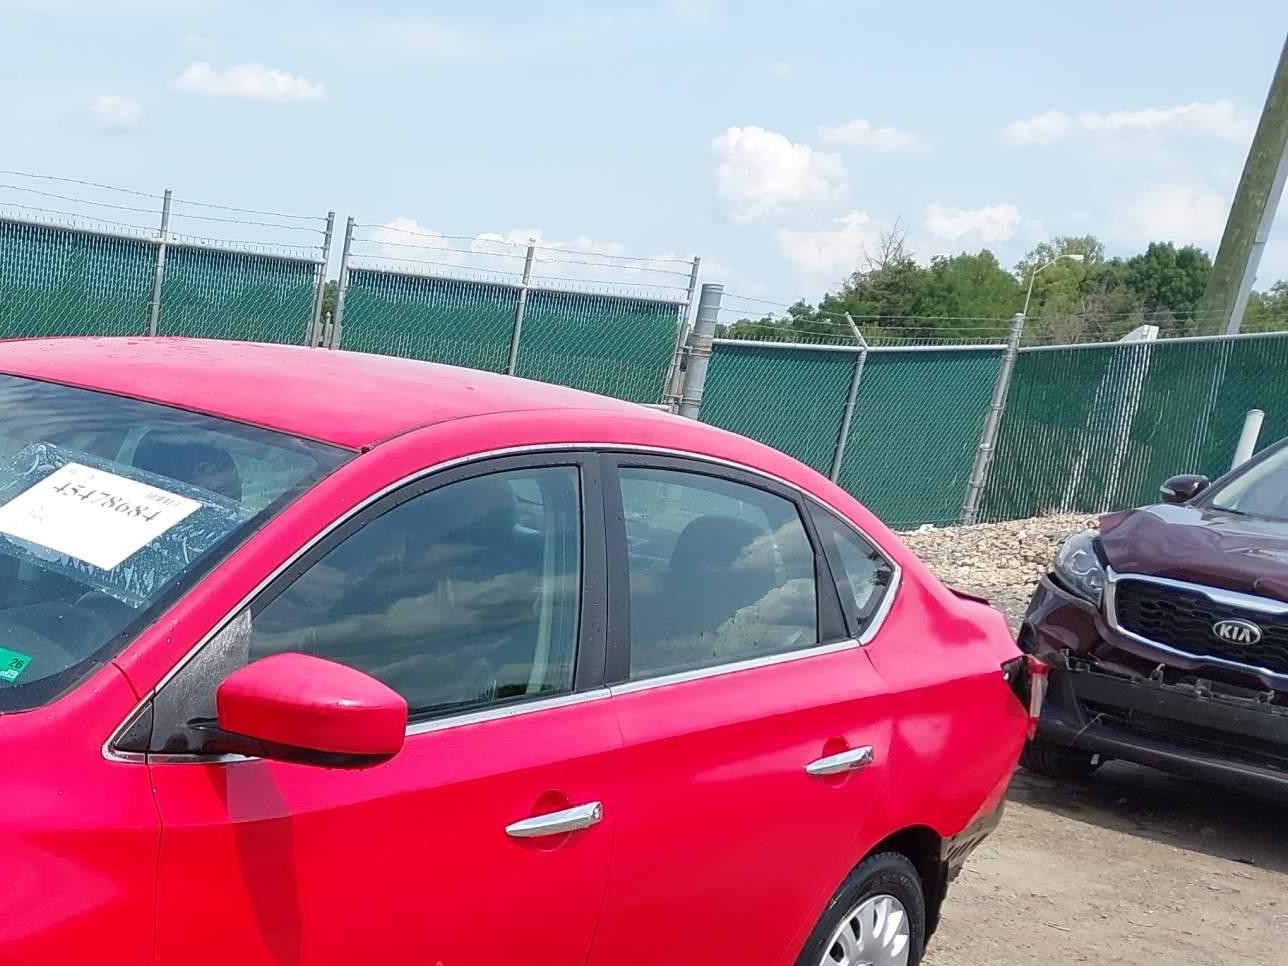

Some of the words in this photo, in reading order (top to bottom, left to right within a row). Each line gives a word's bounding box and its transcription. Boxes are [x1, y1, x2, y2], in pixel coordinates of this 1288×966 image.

[52, 481, 163, 523] 45478684
[1219, 623, 1251, 643] KIA
[7, 657, 25, 670] 26
